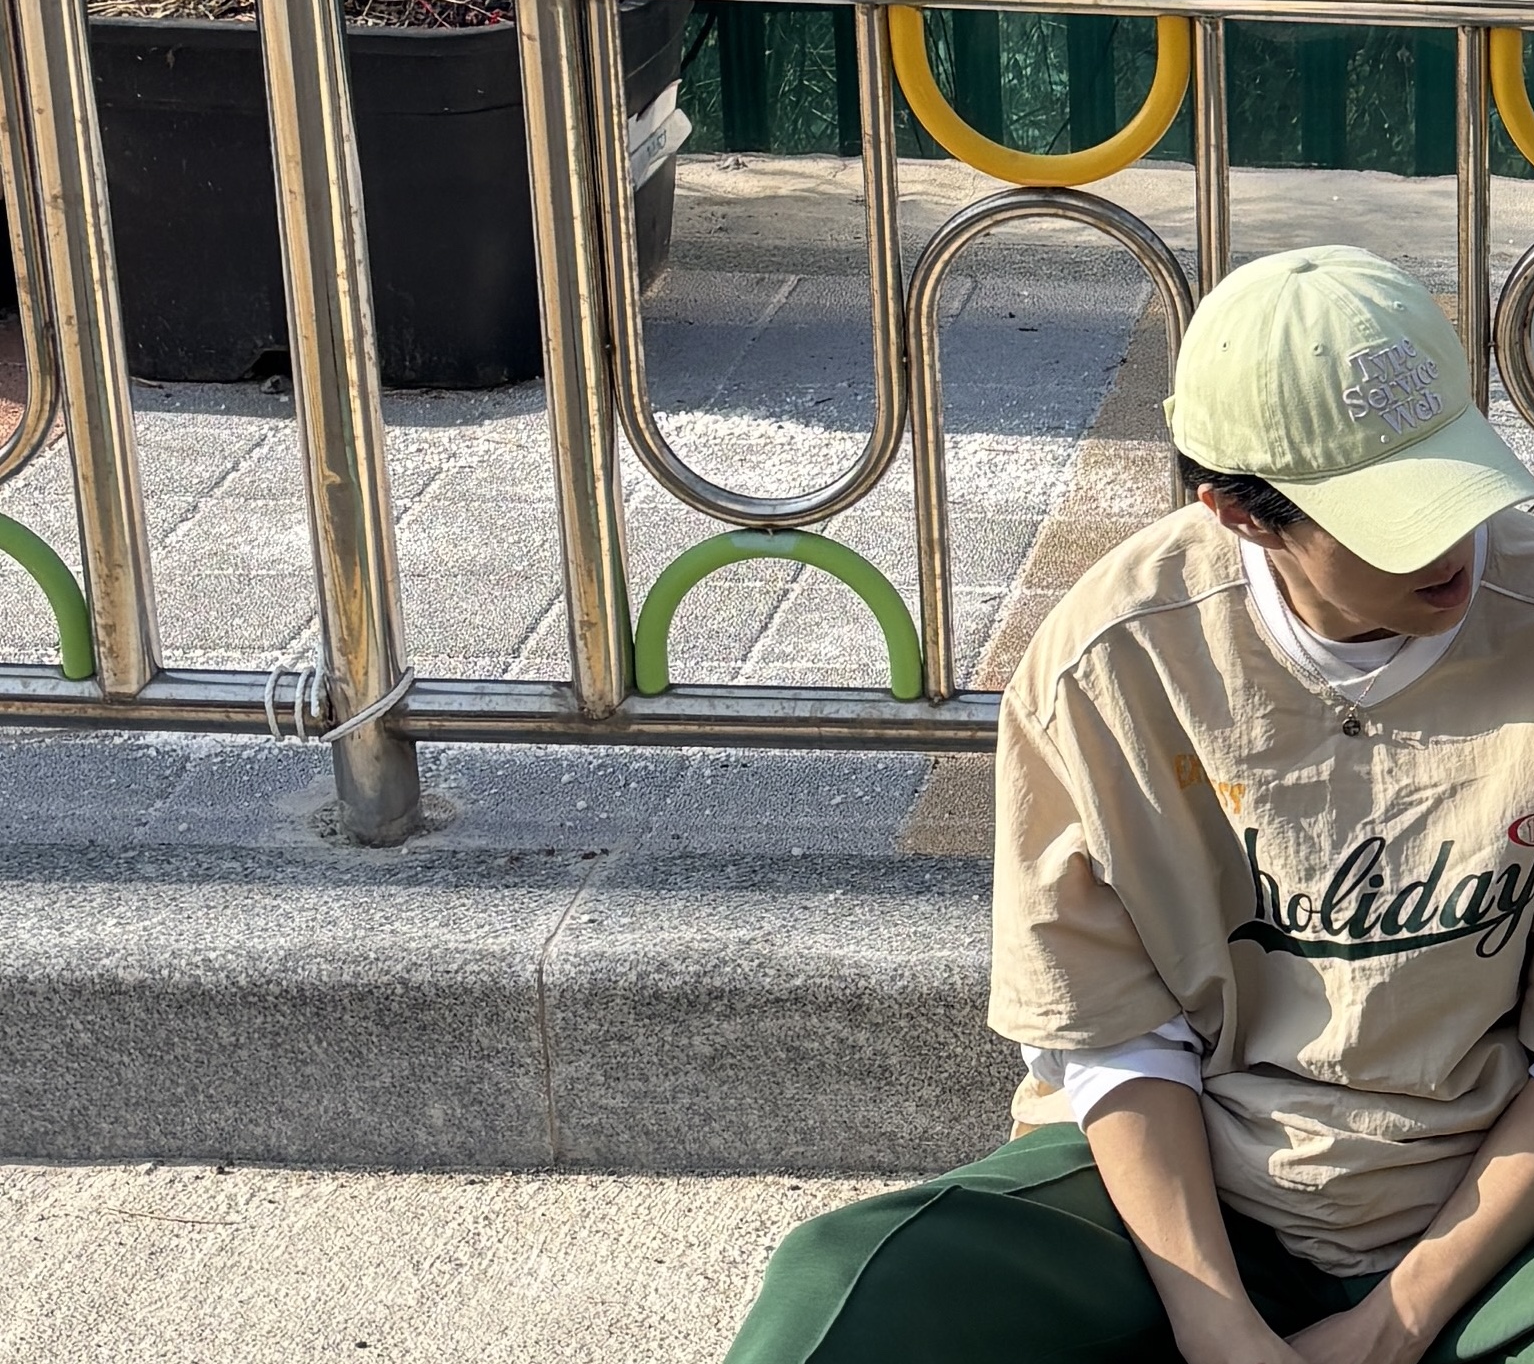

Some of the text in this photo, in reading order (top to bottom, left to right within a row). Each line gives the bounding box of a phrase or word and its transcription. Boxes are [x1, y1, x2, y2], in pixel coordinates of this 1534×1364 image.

[1345, 338, 1417, 383] Type
[1342, 359, 1440, 423] Service
[1378, 389, 1443, 435] Web
